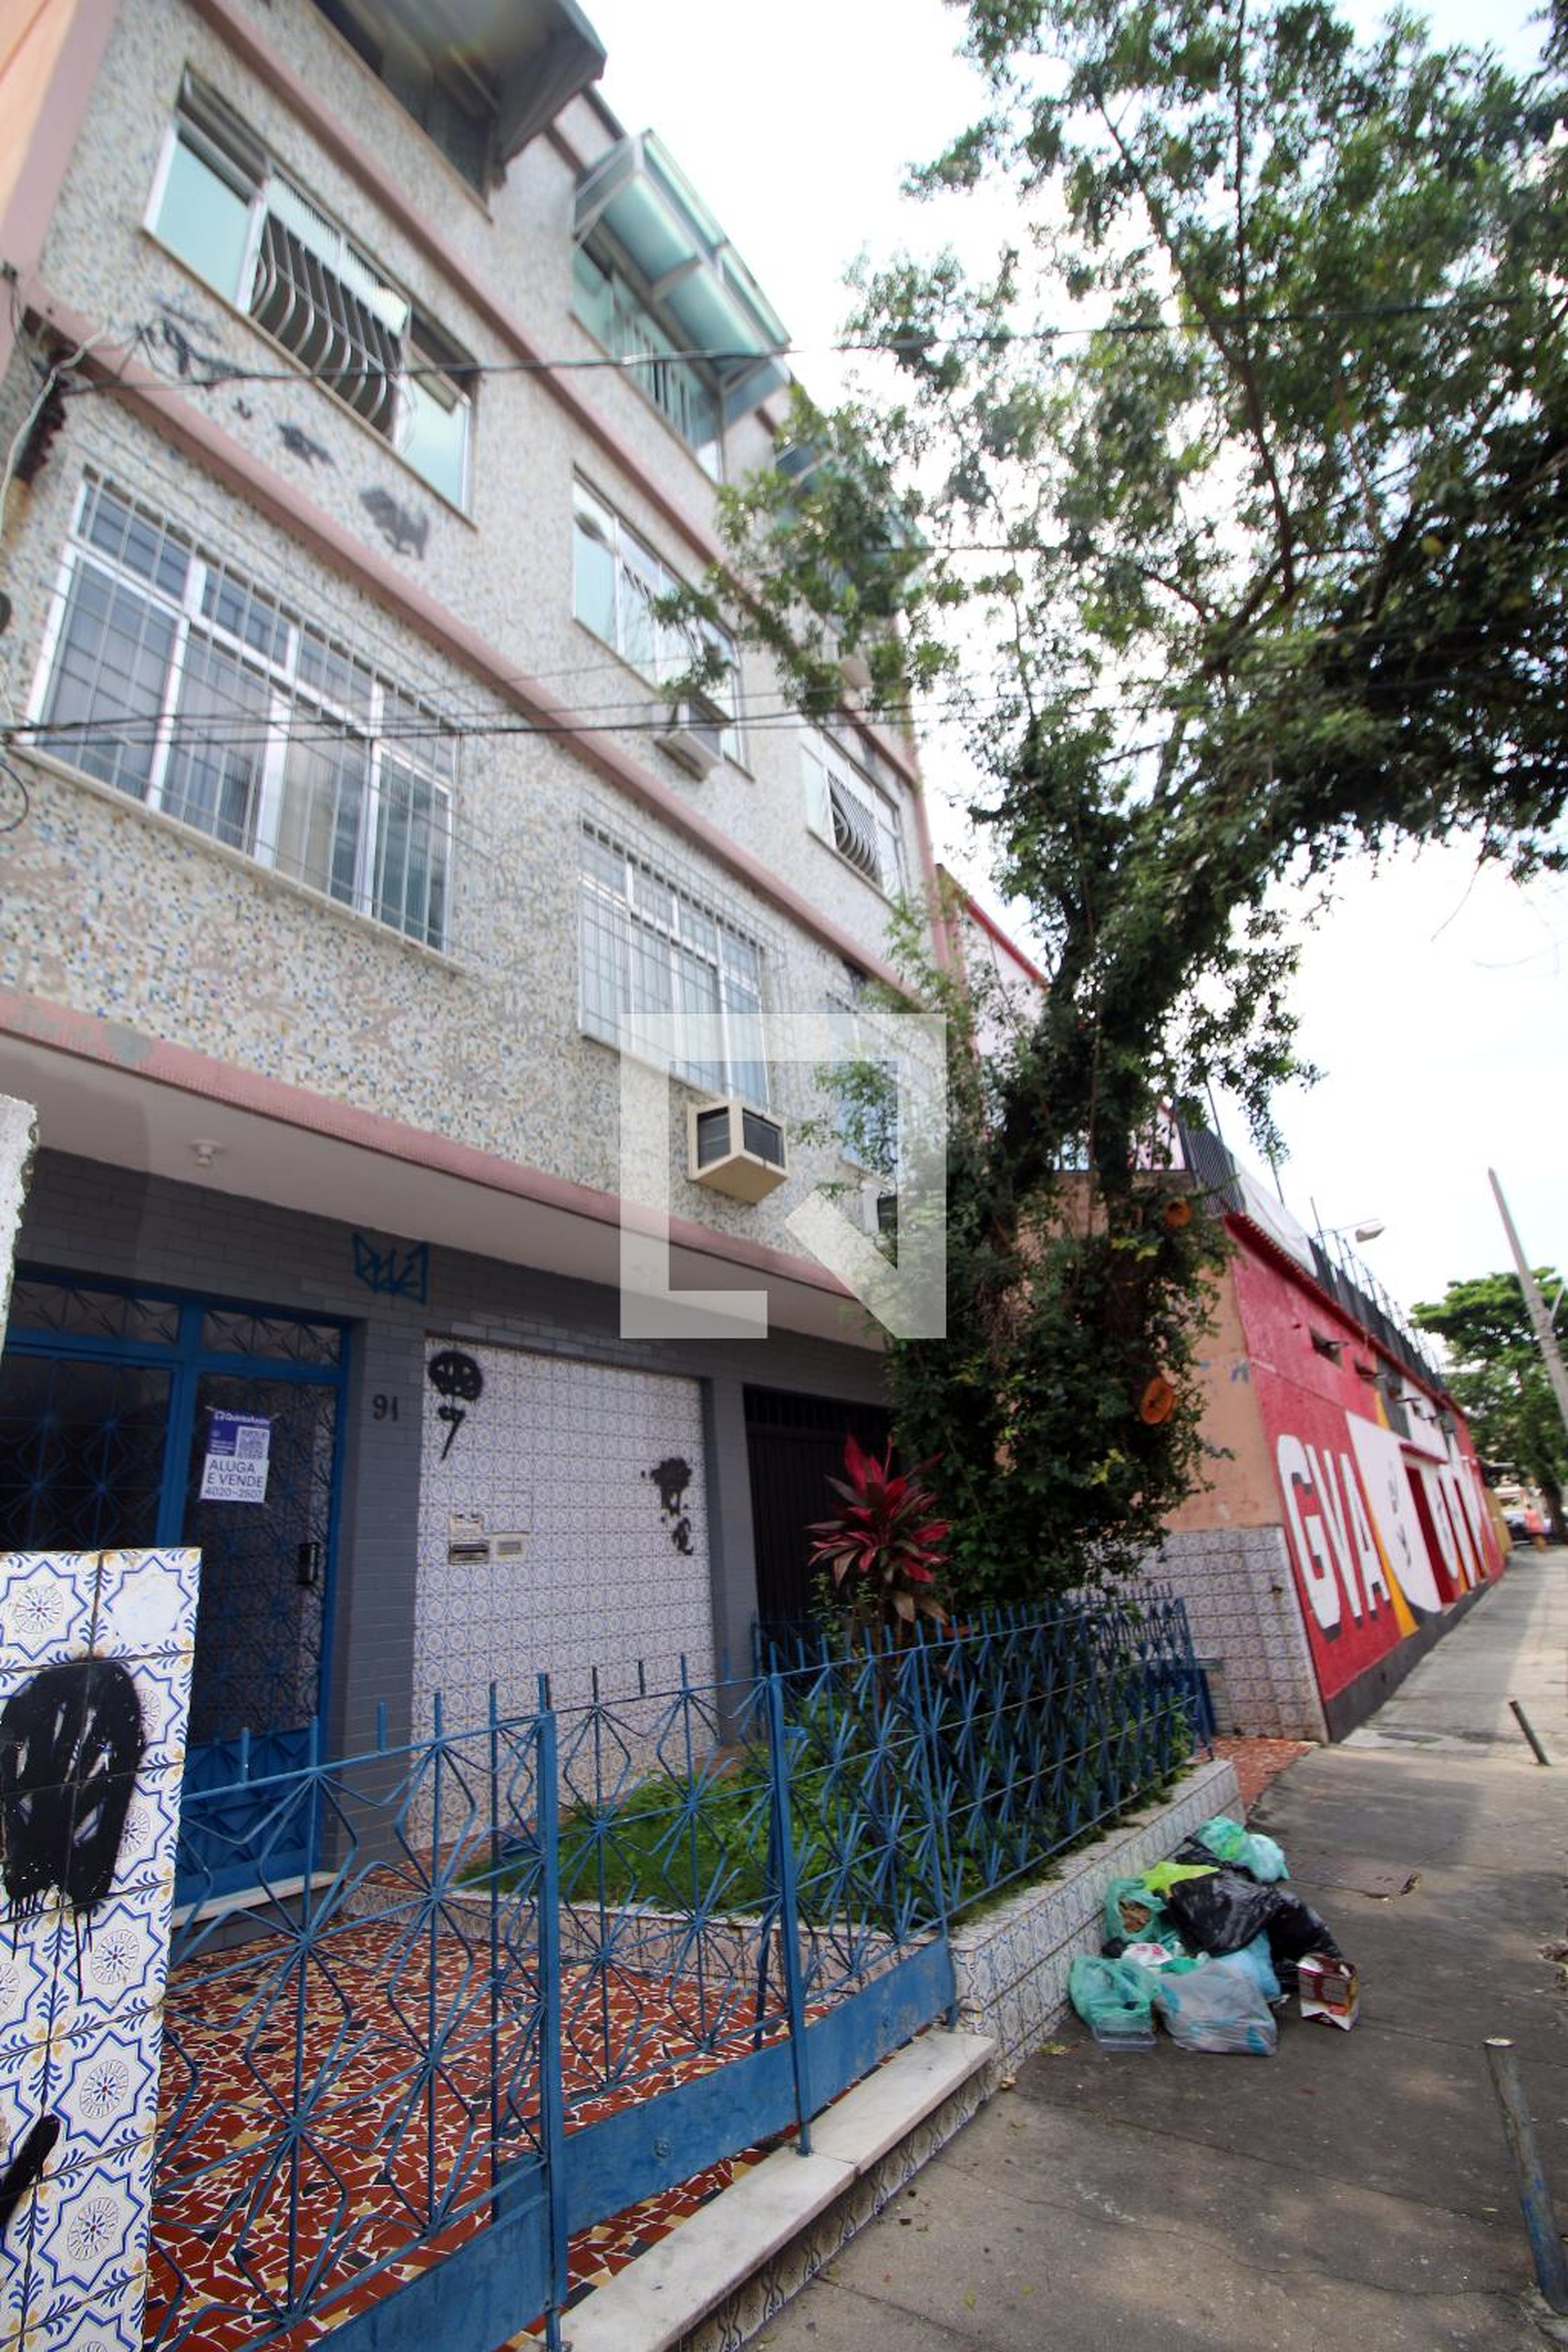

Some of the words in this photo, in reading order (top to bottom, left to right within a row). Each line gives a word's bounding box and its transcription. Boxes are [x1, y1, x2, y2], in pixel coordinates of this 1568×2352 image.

[372, 1394, 398, 1421] 91
[209, 1459, 256, 1473] ALUGA
[207, 1473, 214, 1485] E
[220, 1474, 264, 1488] VENDE
